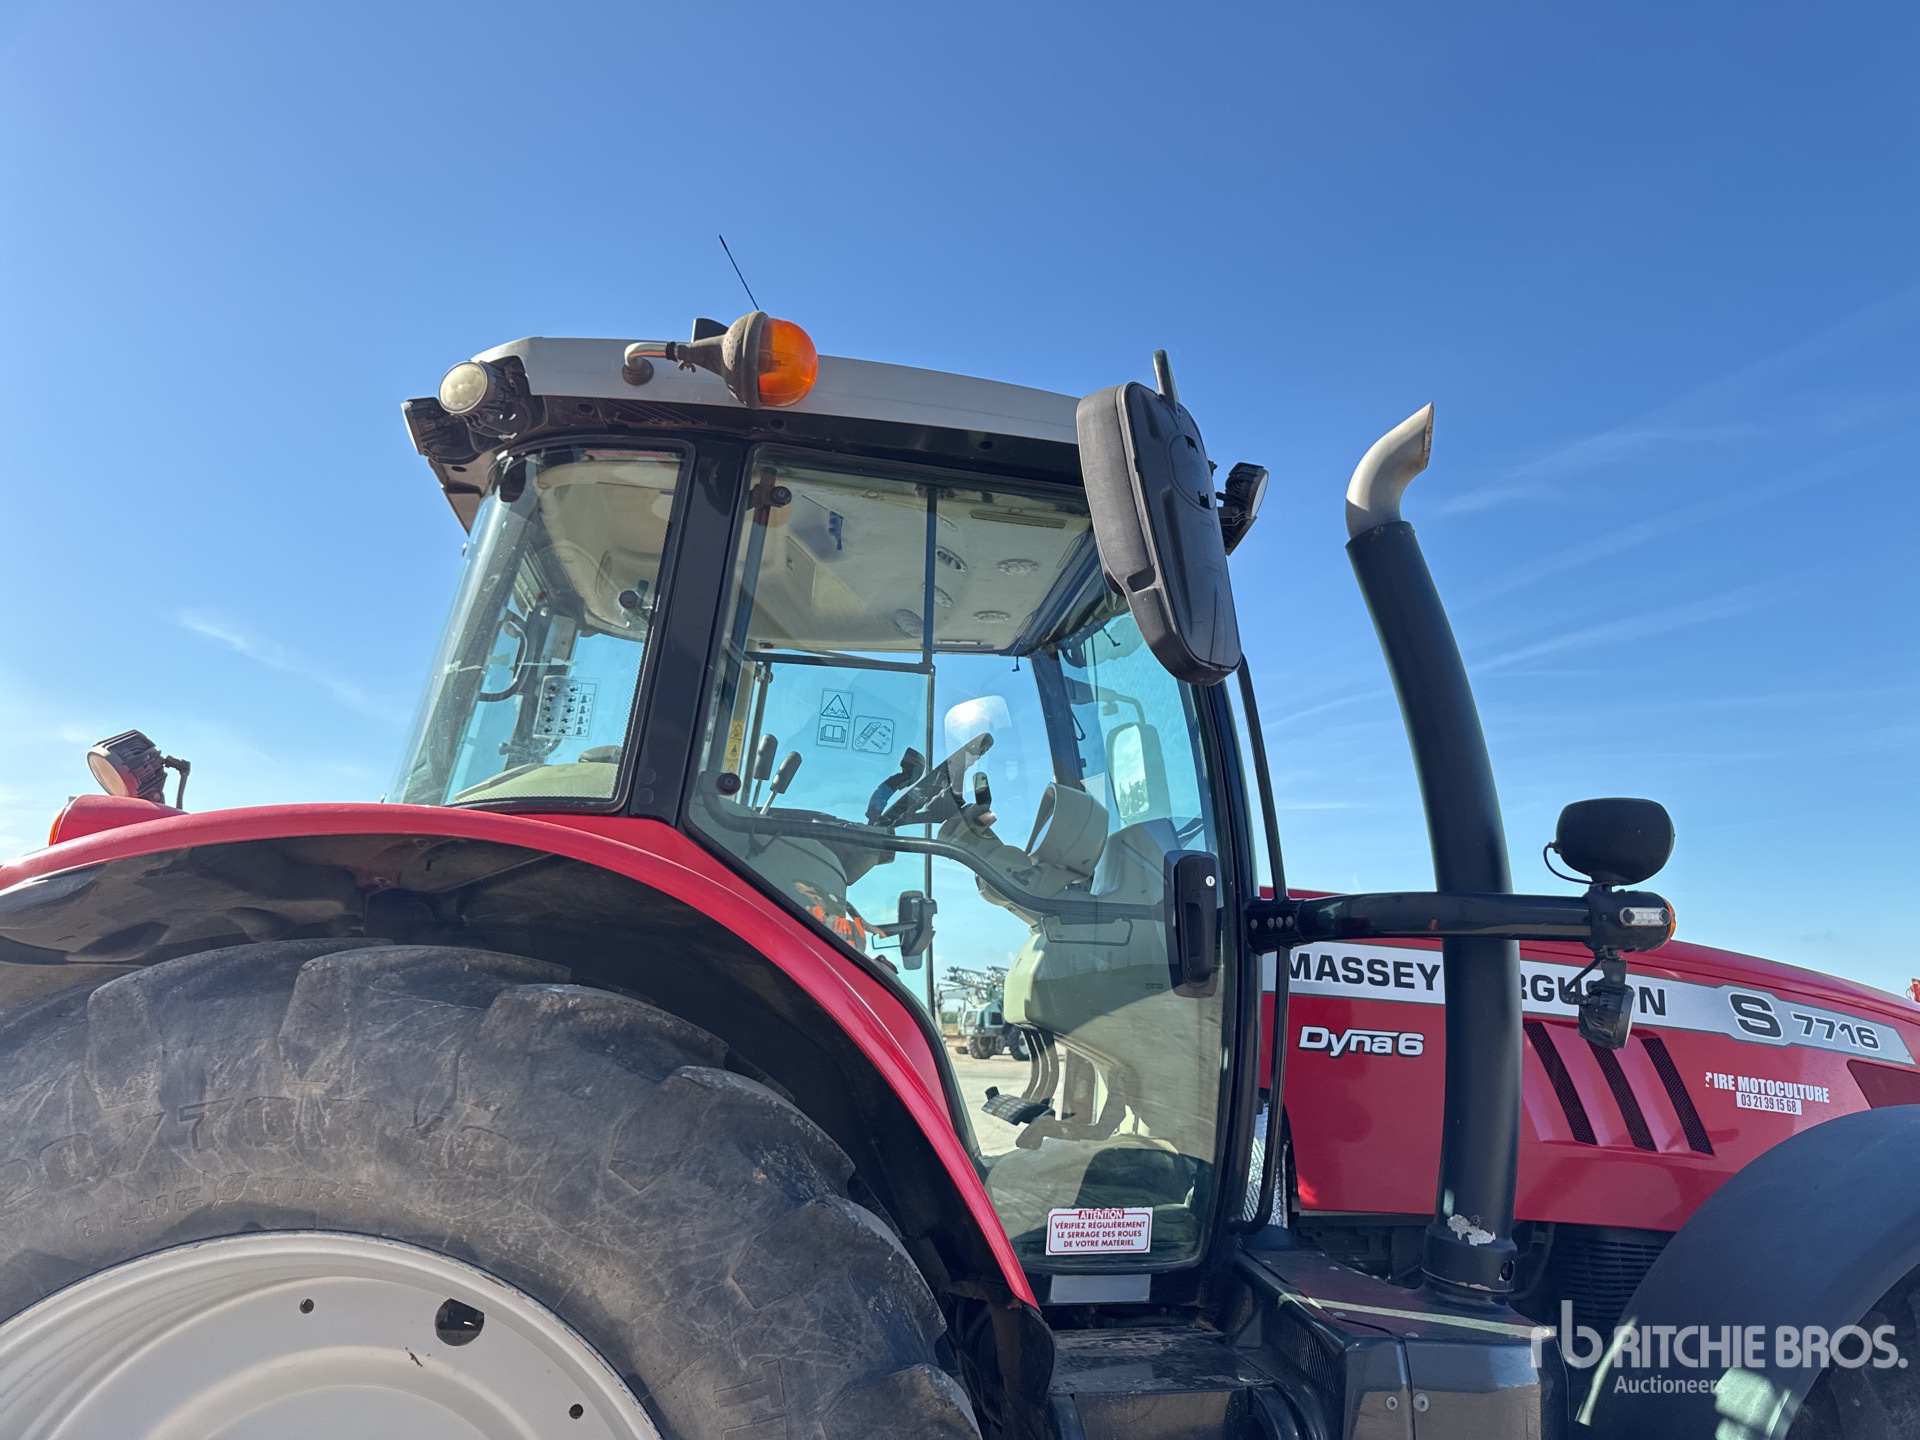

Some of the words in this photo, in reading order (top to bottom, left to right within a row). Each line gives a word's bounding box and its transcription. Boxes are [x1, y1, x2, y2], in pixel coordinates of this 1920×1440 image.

[1289, 952, 1440, 991] MASSEY
[1298, 1025, 1425, 1058] Dyna6
[1791, 1012, 1880, 1050] 7716
[1737, 1076, 1830, 1103] MOTOCULTURE
[1741, 1094, 1752, 1107] 03
[1753, 1095, 1763, 1108] 21
[1764, 1097, 1774, 1110] 39
[1776, 1099, 1785, 1111] 15
[1786, 1100, 1797, 1113] 68
[1055, 1221, 1085, 1229] VÉRIFIEZ
[1088, 1220, 1146, 1228] RÉGULIÈREMENT
[1080, 1210, 1123, 1219] ATTENTION
